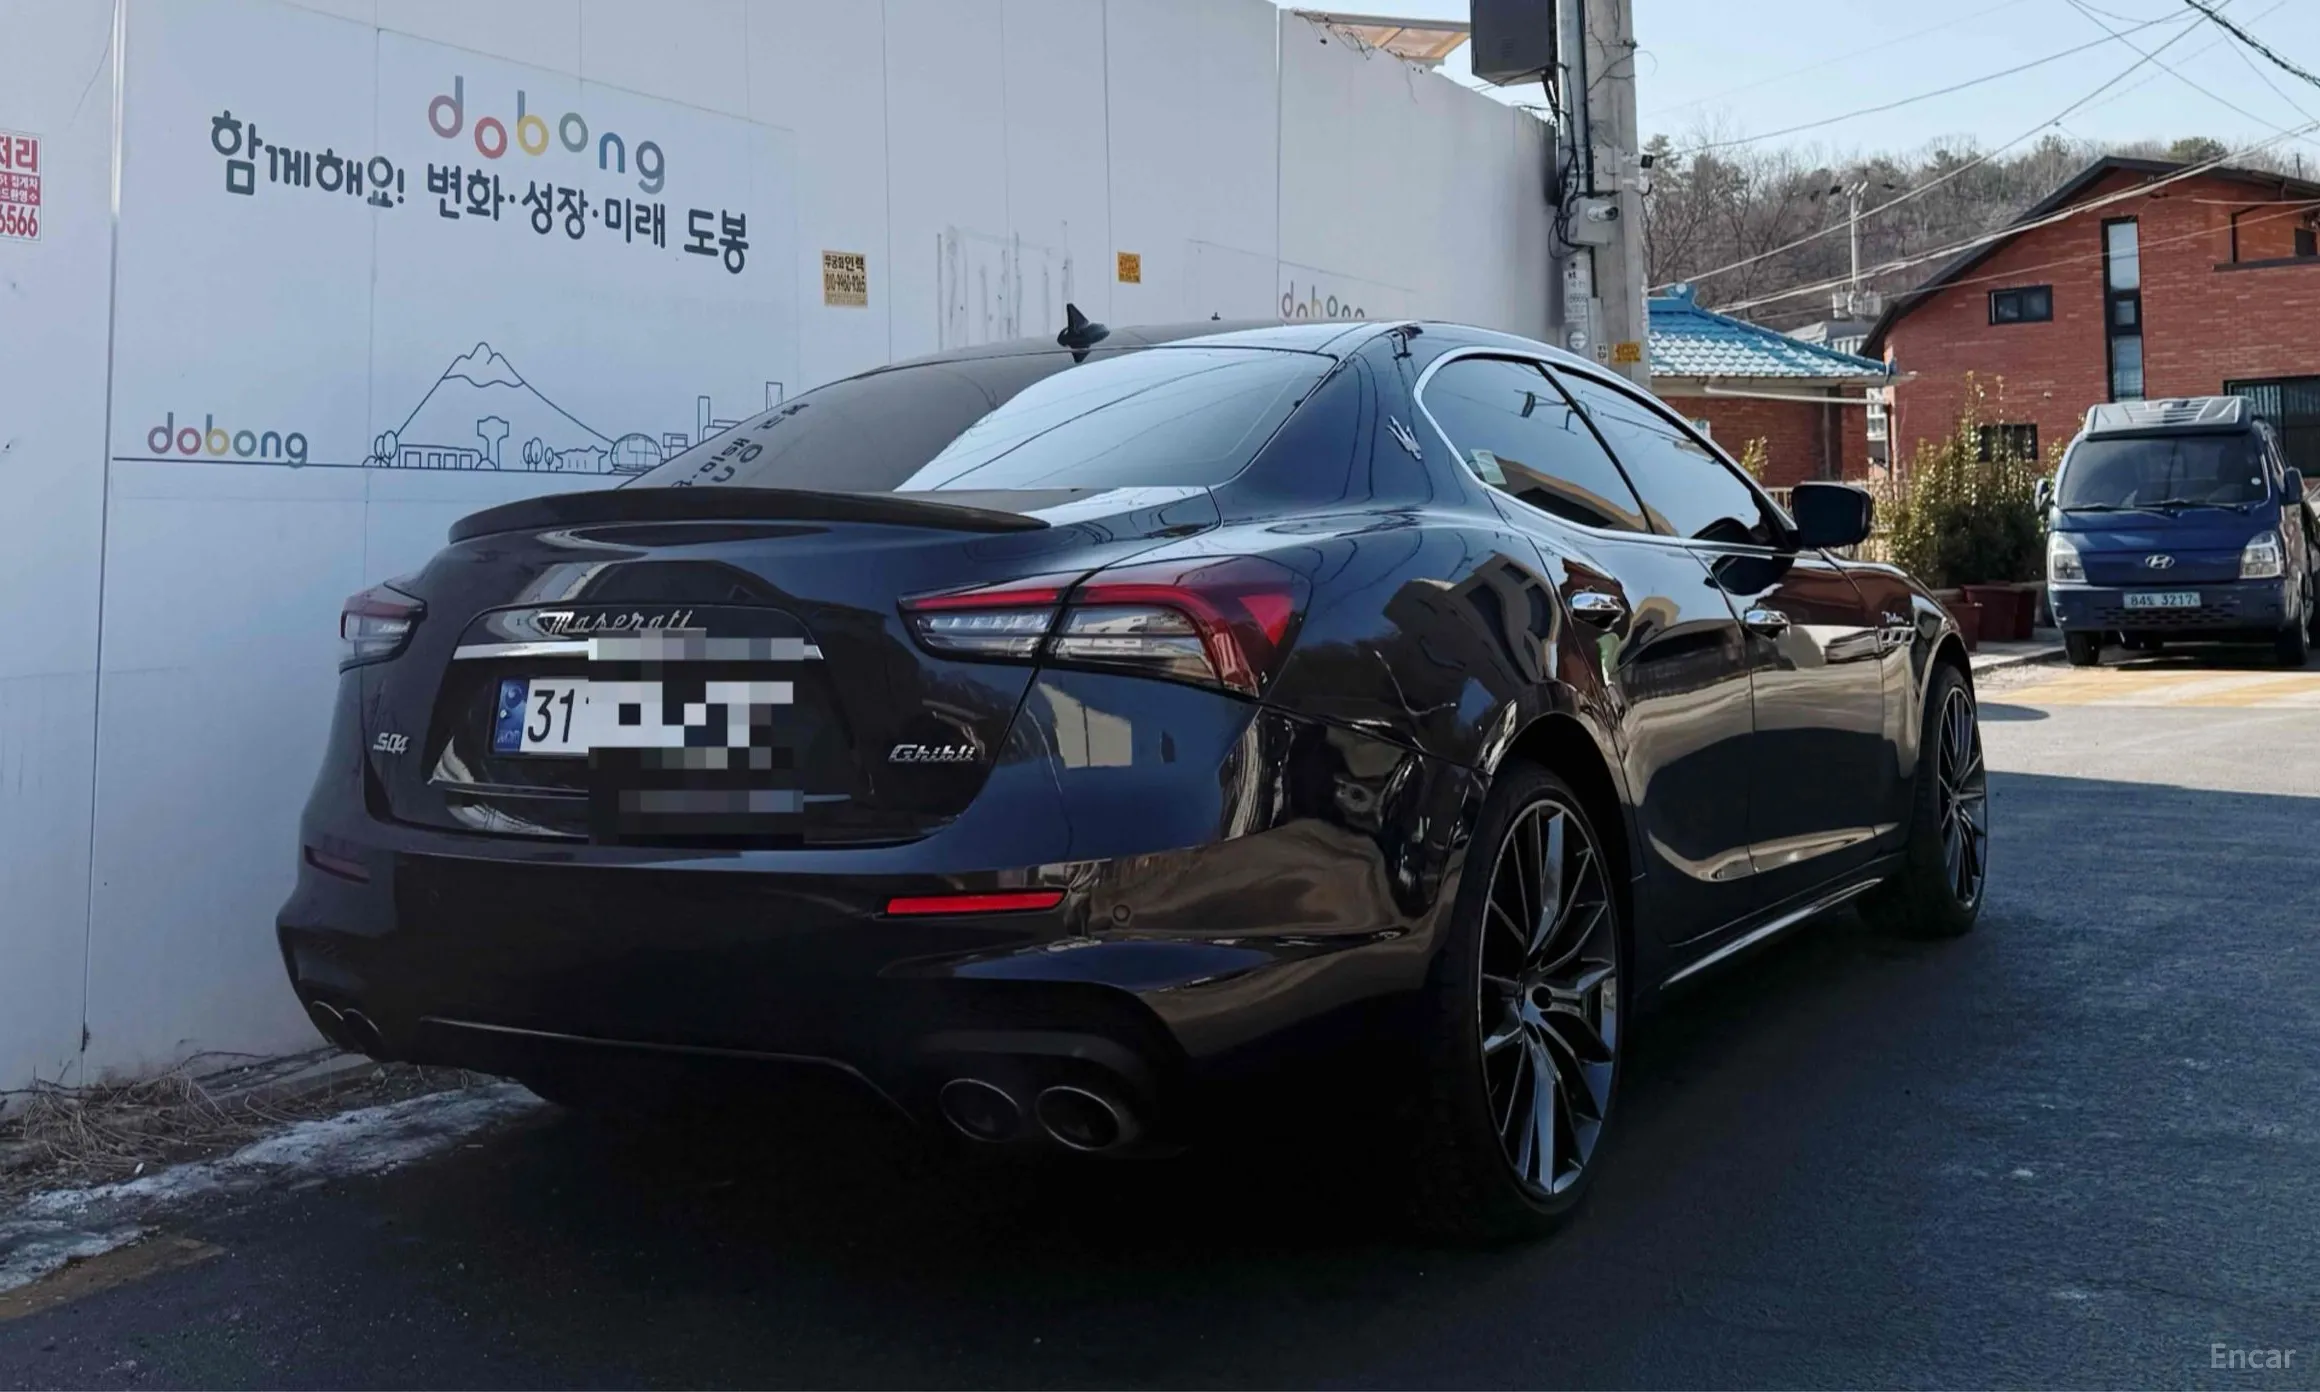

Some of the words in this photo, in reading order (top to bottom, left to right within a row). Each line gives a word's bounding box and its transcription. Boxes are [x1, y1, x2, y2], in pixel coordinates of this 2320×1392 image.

[428, 75, 665, 195] dobong
[211, 109, 405, 208] 함께해요!
[683, 209, 750, 274] 도봉
[1282, 280, 1365, 318] dobon
[147, 411, 308, 469] dobong
[537, 609, 700, 634] Maserati
[527, 688, 588, 744] 31
[373, 731, 410, 755] SQ4
[888, 743, 976, 762] Ghibli
